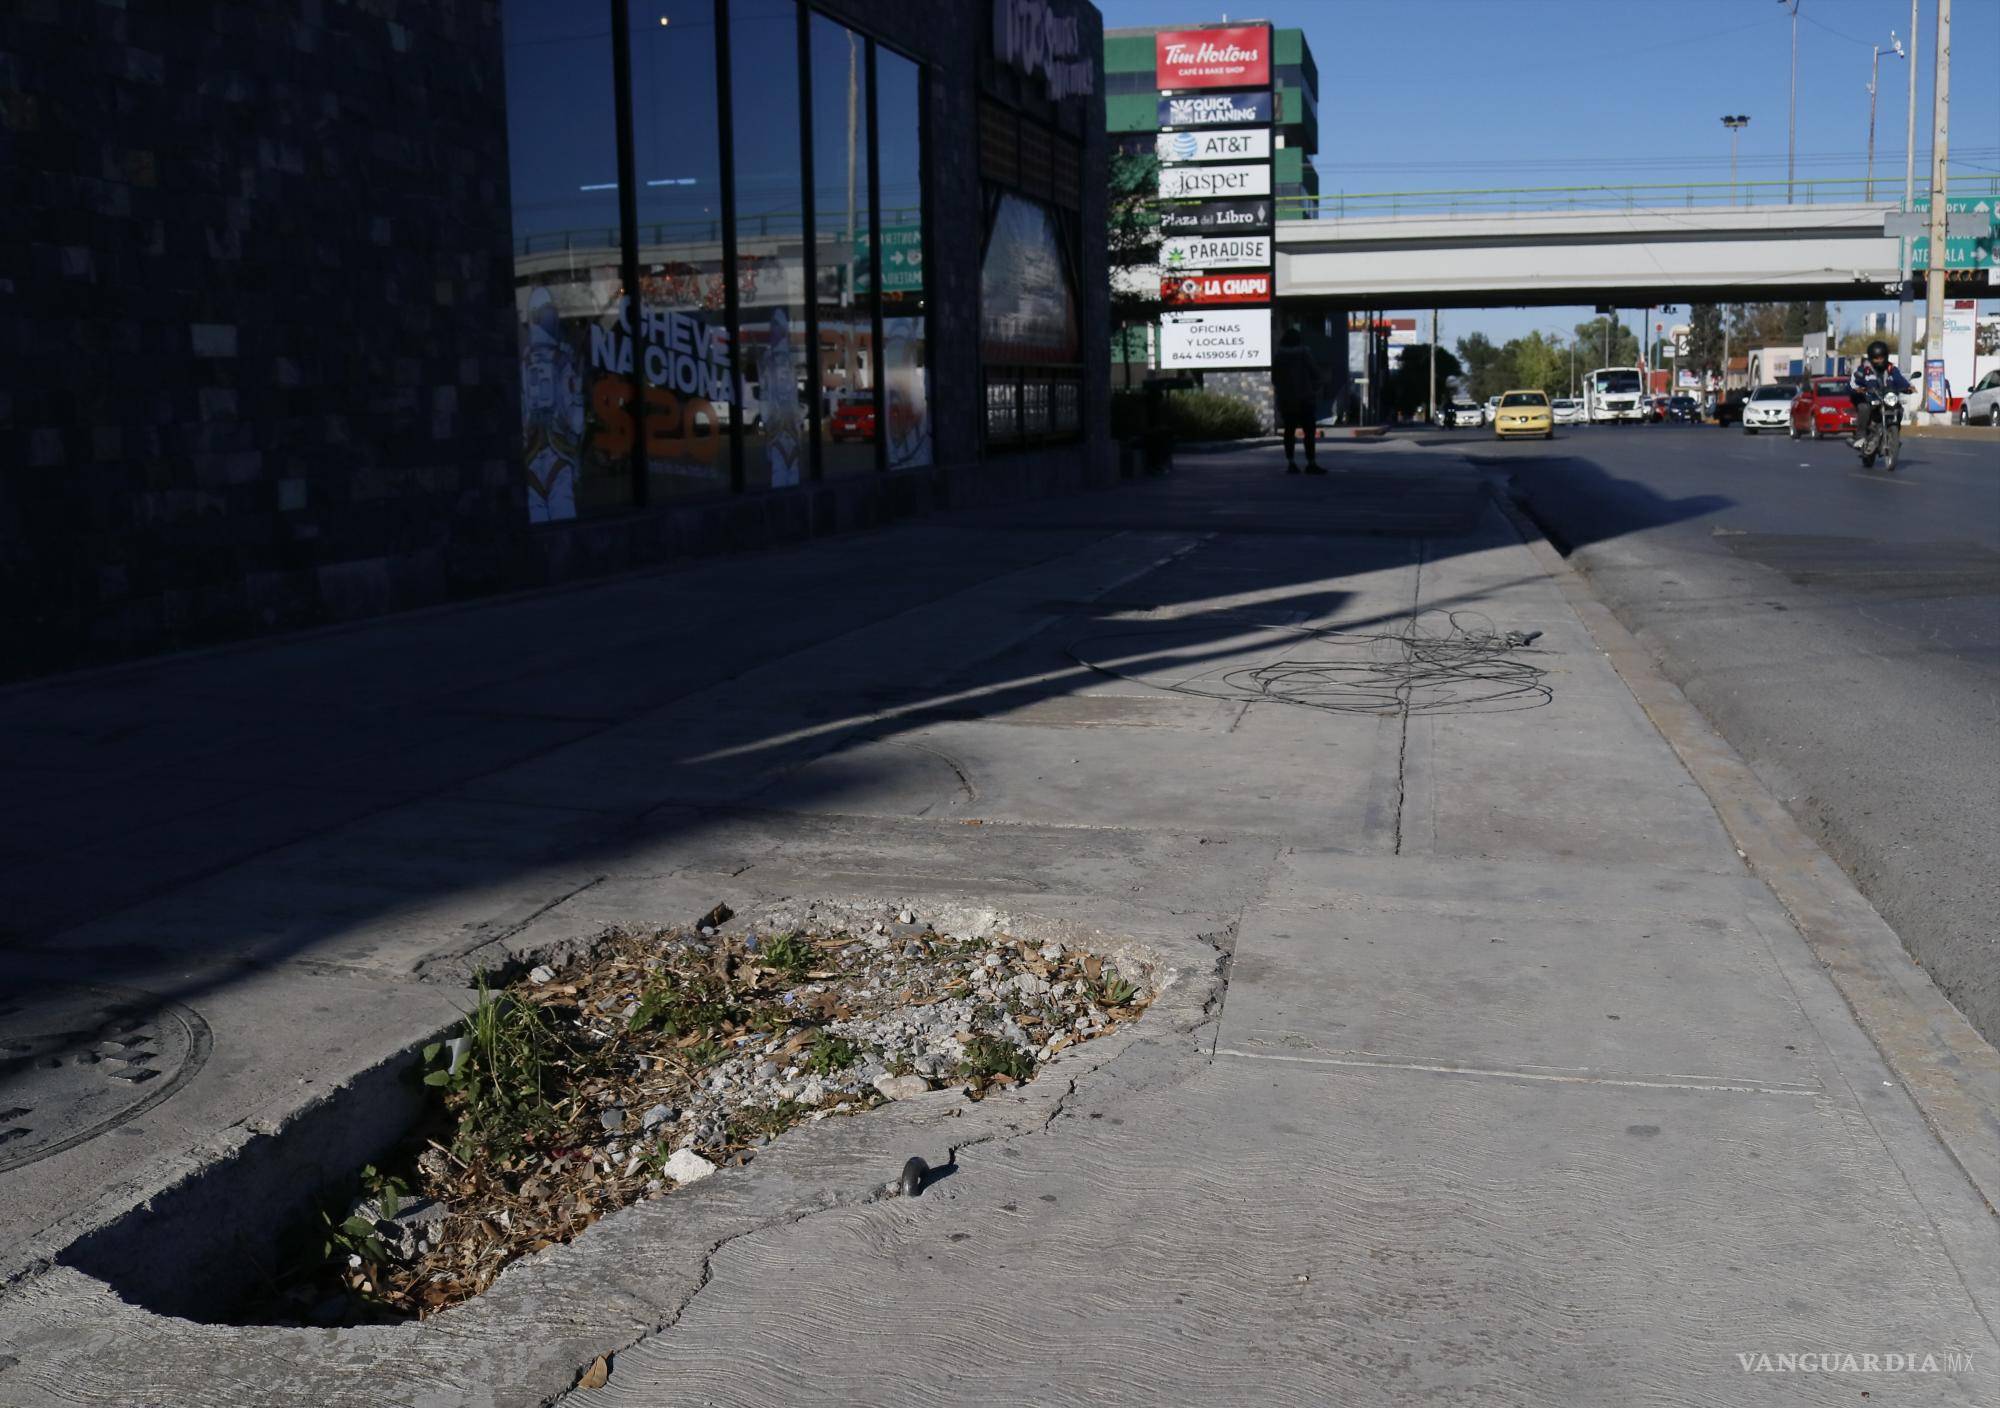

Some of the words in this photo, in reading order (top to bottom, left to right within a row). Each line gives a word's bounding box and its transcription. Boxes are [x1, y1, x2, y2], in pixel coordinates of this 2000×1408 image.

[1165, 44, 1195, 65] Tim
[1197, 42, 1258, 63] Hortons
[1205, 67, 1224, 75] BAKE
[1225, 66, 1245, 74] SHOP
[1193, 97, 1233, 111] QUICK
[1195, 107, 1256, 123] LEARNING
[1205, 136, 1252, 153] AT&T
[1179, 171, 1249, 194] jasper
[1161, 212, 1198, 227] Plaza
[1200, 214, 1214, 224] del
[1216, 209, 1254, 224] Libro
[1190, 241, 1265, 259] PARADISE
[1204, 281, 1221, 296] LA
[1222, 279, 1267, 295] CHAPU
[620, 294, 731, 368] CHEVE
[1190, 324, 1241, 334] OFICINAS
[1186, 338, 1193, 347] Y
[1196, 337, 1245, 346] LOCALES
[1172, 351, 1192, 360] 844
[1247, 350, 1259, 358] 57
[592, 373, 720, 464] $20
